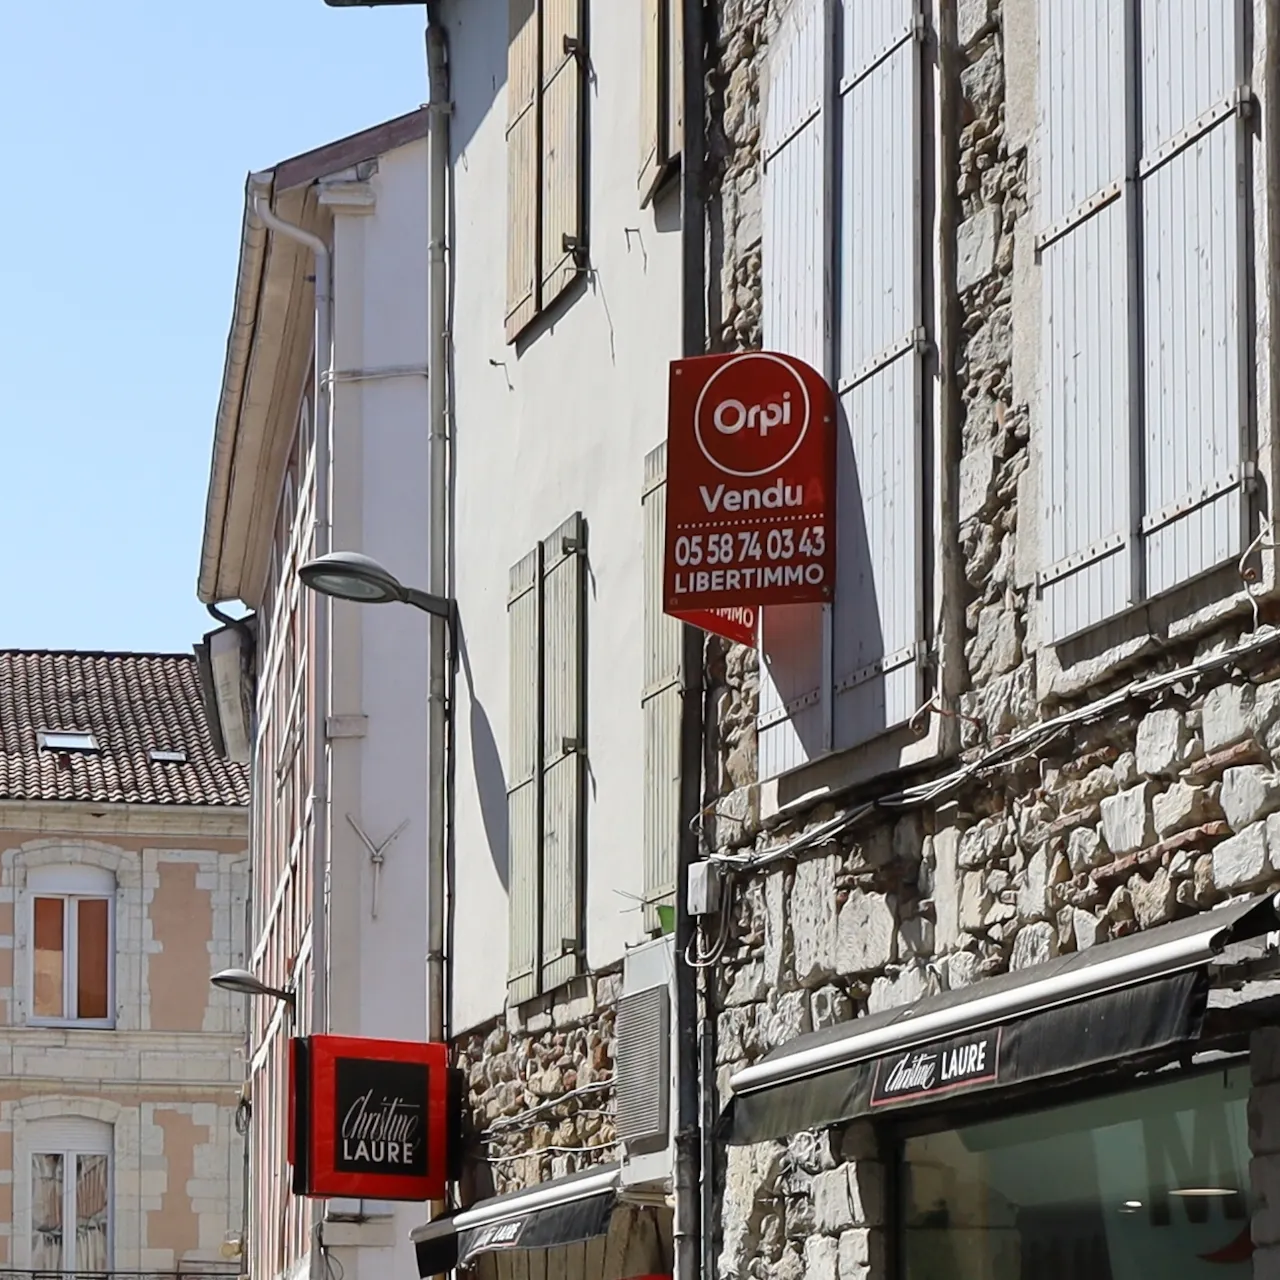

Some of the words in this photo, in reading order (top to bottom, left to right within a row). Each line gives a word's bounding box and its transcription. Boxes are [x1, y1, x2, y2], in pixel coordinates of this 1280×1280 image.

[714, 391, 791, 436] Orpi
[699, 478, 803, 513] Vendu
[675, 535, 703, 567] 05
[707, 532, 734, 565] 58
[738, 531, 762, 563] 74
[767, 528, 794, 560] 03
[799, 526, 825, 557] 43
[675, 563, 825, 594] LIBERTIMMO
[884, 1052, 937, 1093] Christine
[941, 1041, 987, 1080] LAURE
[342, 1088, 421, 1147] Christine
[343, 1139, 413, 1164] LAURE
